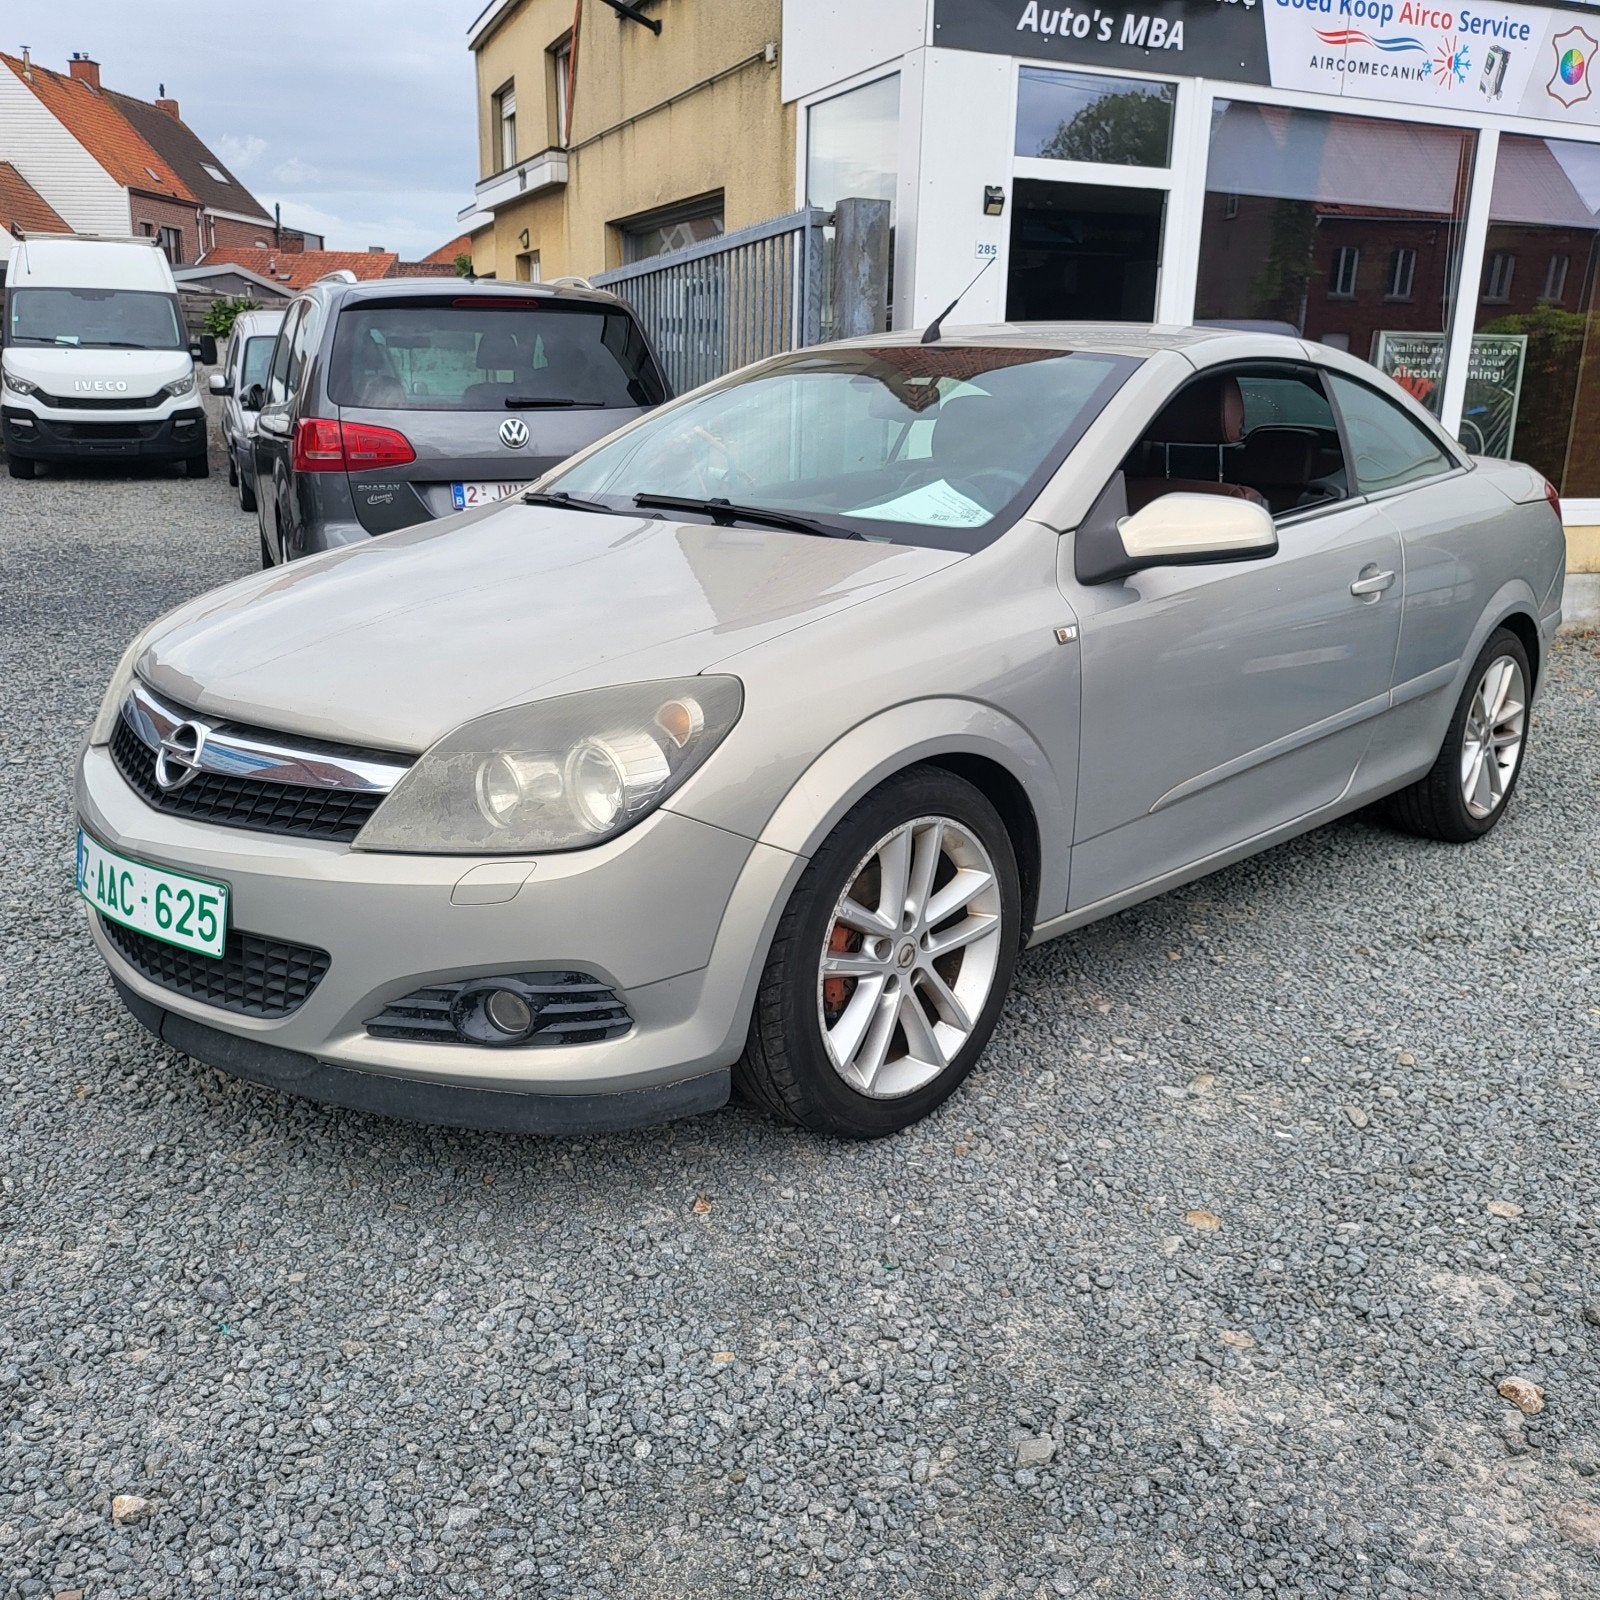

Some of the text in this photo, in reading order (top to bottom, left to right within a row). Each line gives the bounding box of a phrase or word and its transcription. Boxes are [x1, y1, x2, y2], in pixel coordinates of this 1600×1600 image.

[1016, 1, 1184, 51] Auto's MBA
[1340, 0, 1394, 28] Koop
[1398, 2, 1453, 31] Airco
[1458, 11, 1531, 41] Service
[1309, 55, 1425, 82] AIRCOMECANIK
[978, 244, 997, 254] 285
[1386, 343, 1430, 354] Kwaliteit
[1482, 347, 1499, 356] aan
[1500, 347, 1518, 356] een
[1394, 354, 1432, 365] Scherpe
[74, 380, 128, 392] IVECO
